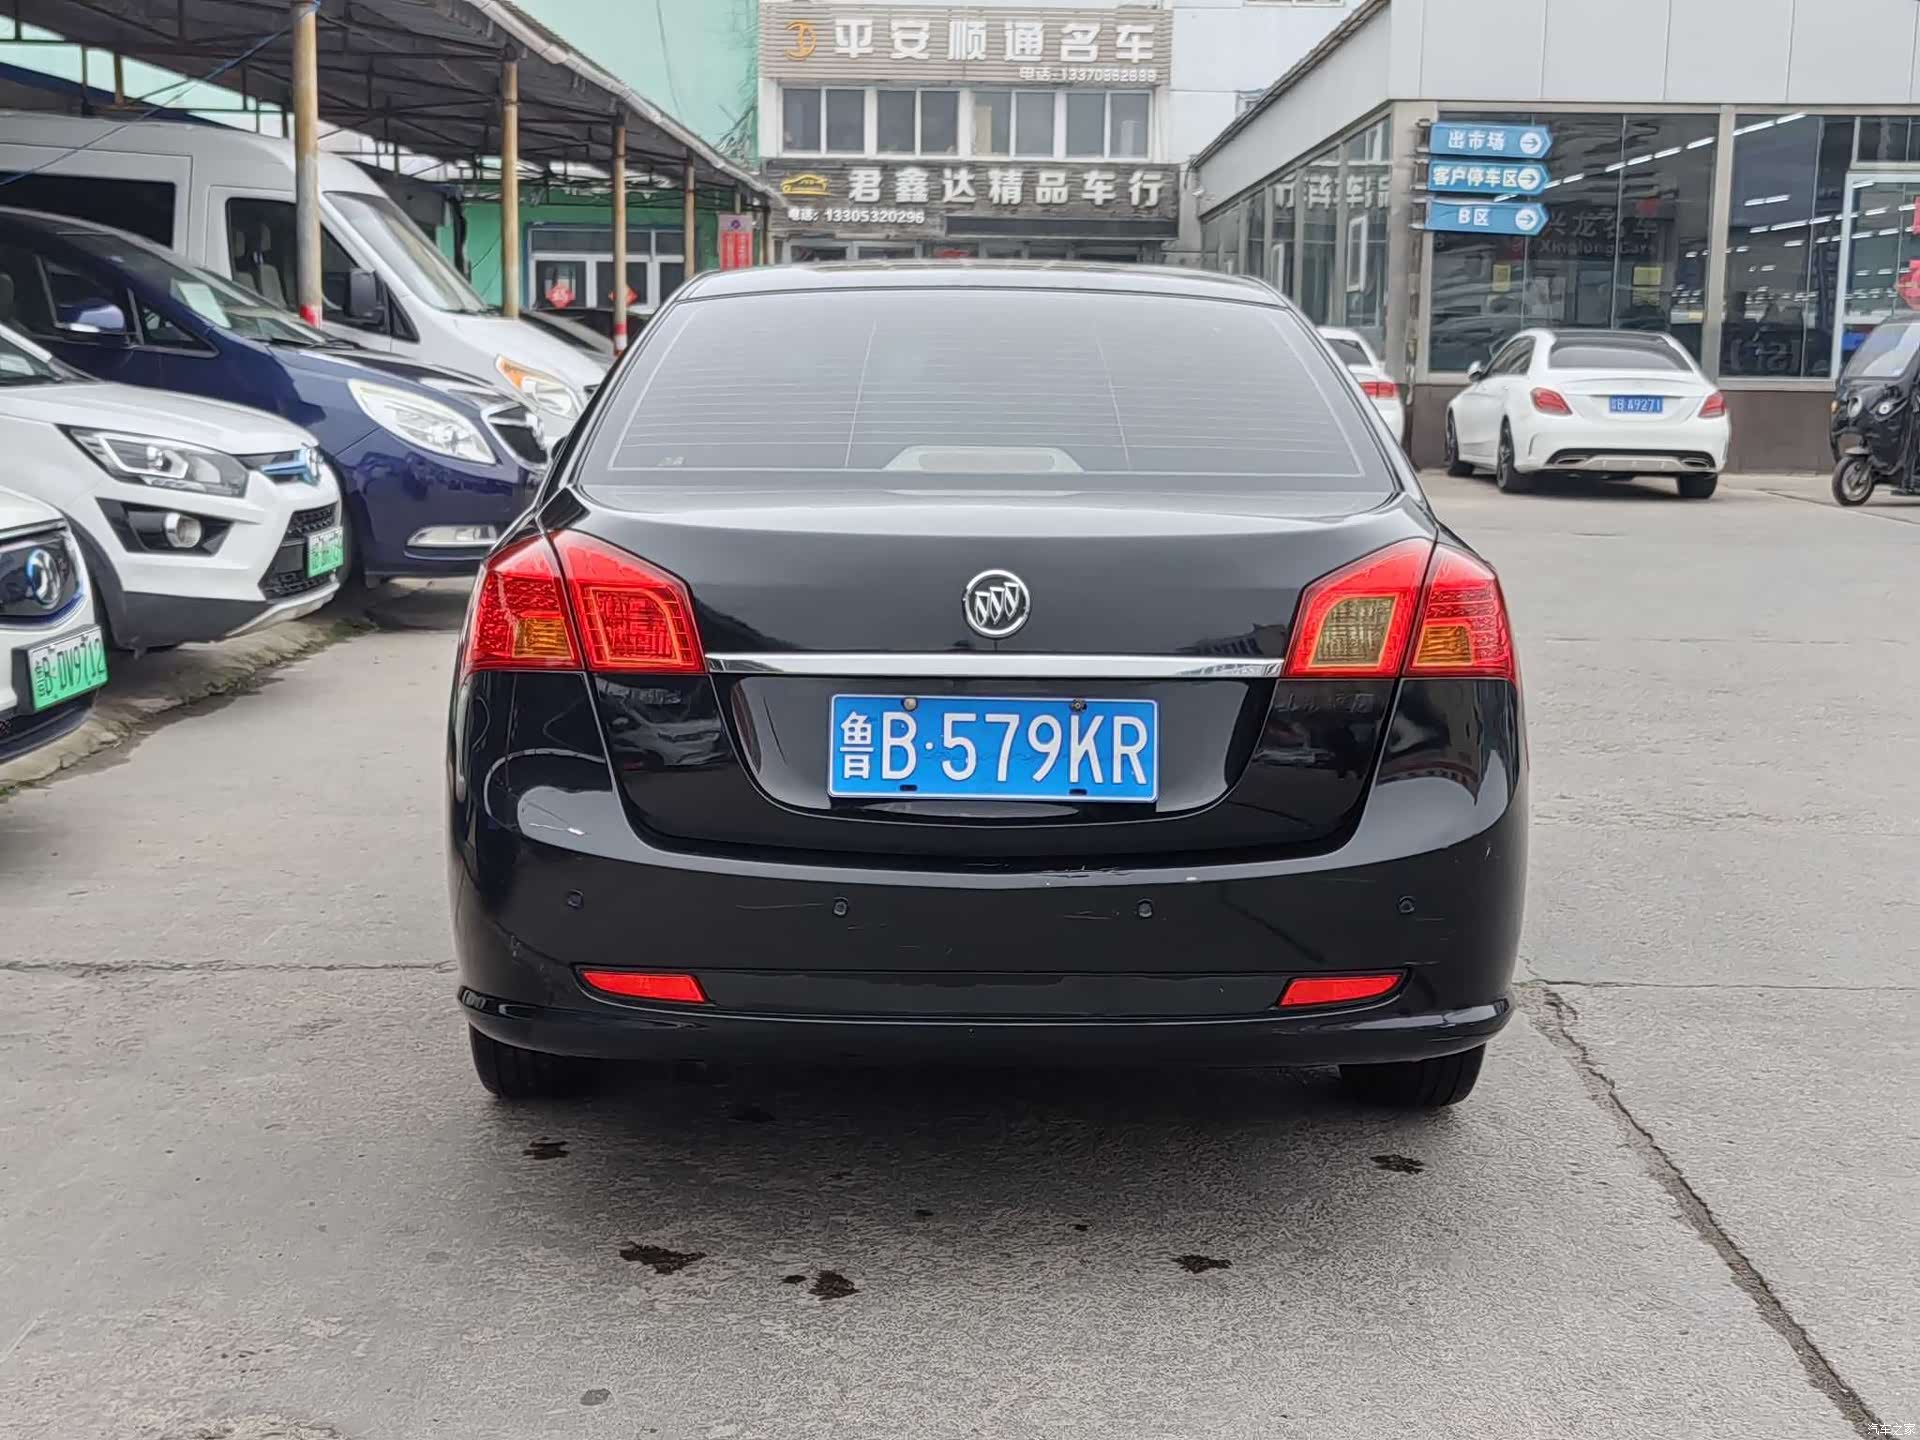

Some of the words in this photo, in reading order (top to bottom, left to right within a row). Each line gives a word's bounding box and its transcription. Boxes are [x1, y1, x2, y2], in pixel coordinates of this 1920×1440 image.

[834, 19, 1155, 62] 平安顺通名车
[1448, 129, 1505, 150] 出市场
[849, 168, 1164, 207] 君鑫达精品车行
[1433, 166, 1519, 188] 客户停车区
[1458, 207, 1489, 226] B区
[840, 711, 1148, 785] 鲁B·579KR
